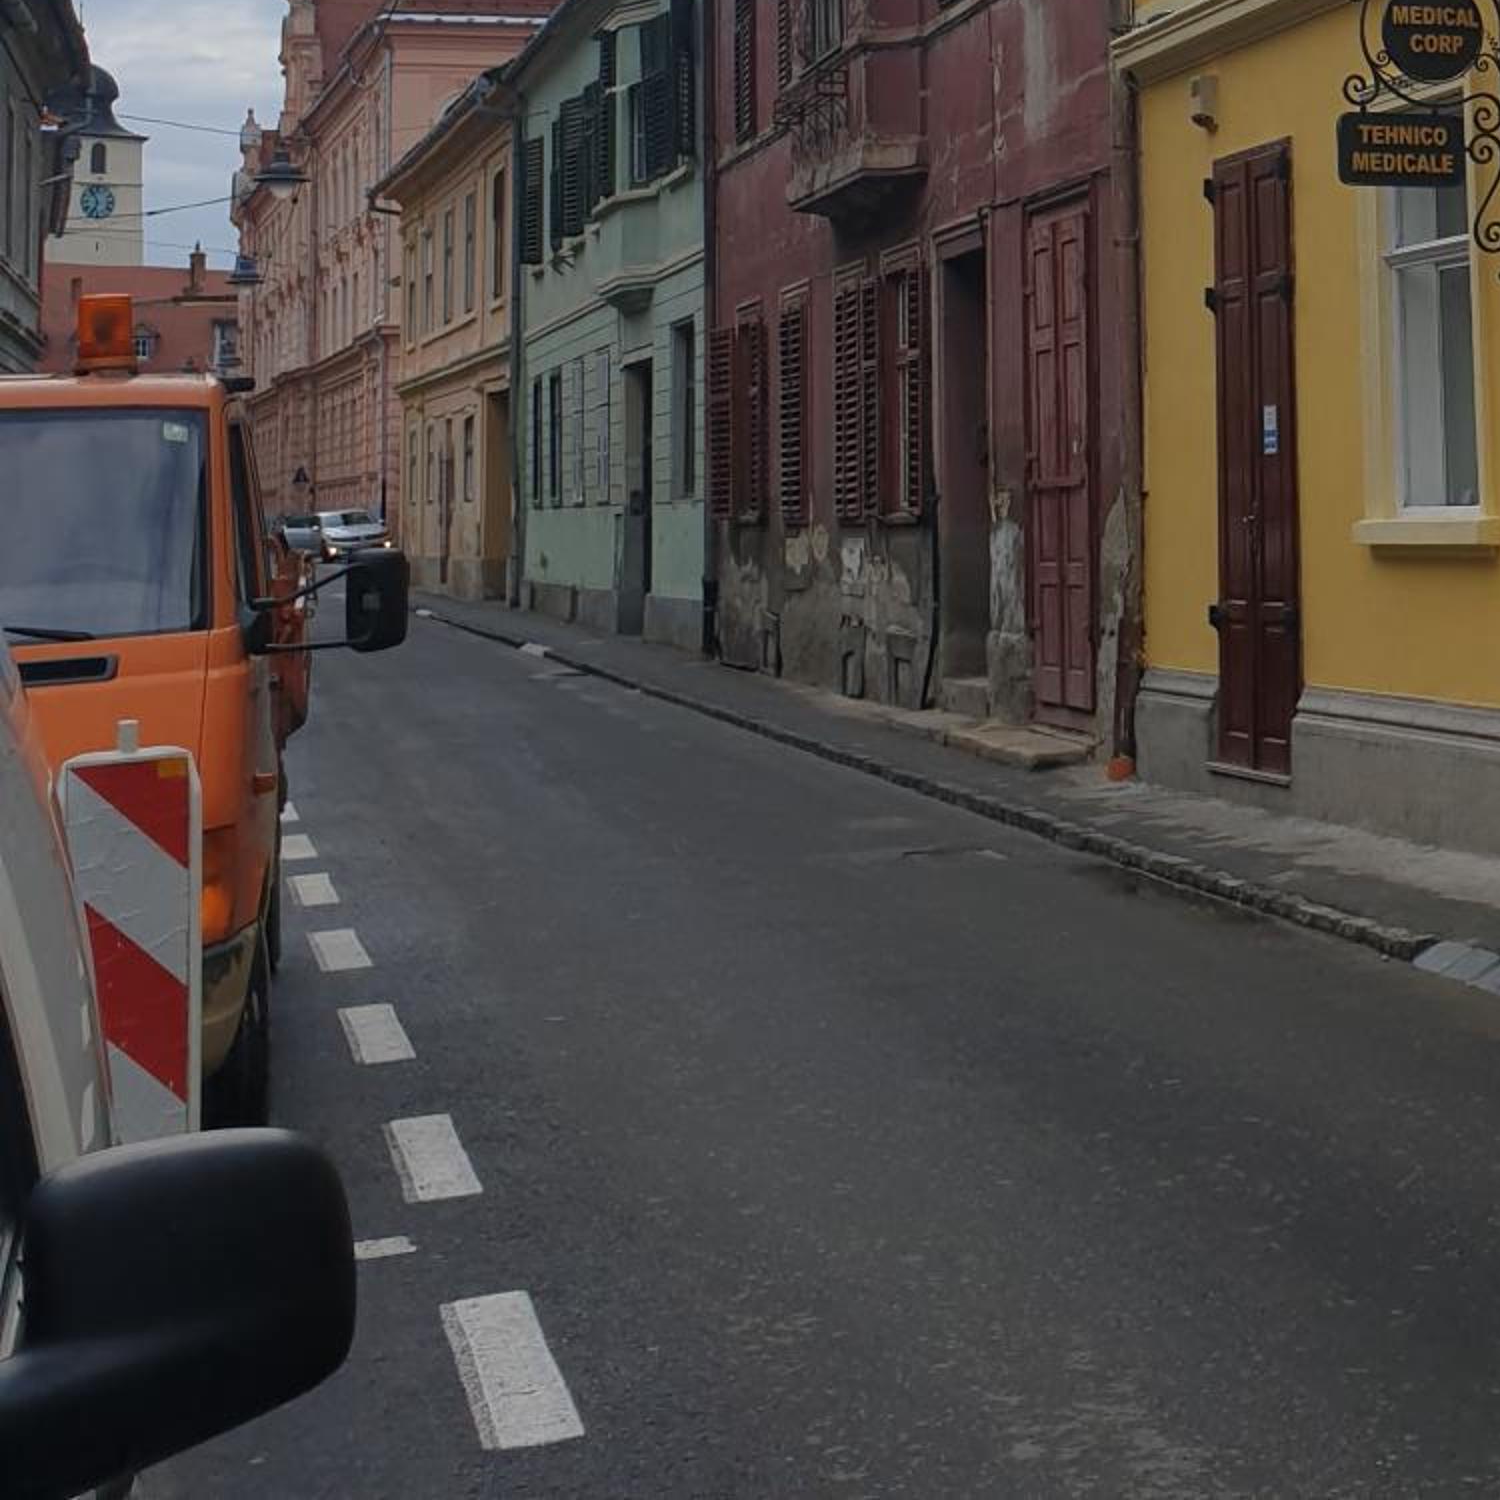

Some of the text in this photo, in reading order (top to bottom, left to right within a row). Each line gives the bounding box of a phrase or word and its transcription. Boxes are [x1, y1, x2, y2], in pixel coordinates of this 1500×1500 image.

[1392, 6, 1479, 28] MEDICAL
[1410, 34, 1463, 54] CORP
[1359, 125, 1448, 146] TEHNICO
[1352, 152, 1454, 174] MEDICALE
